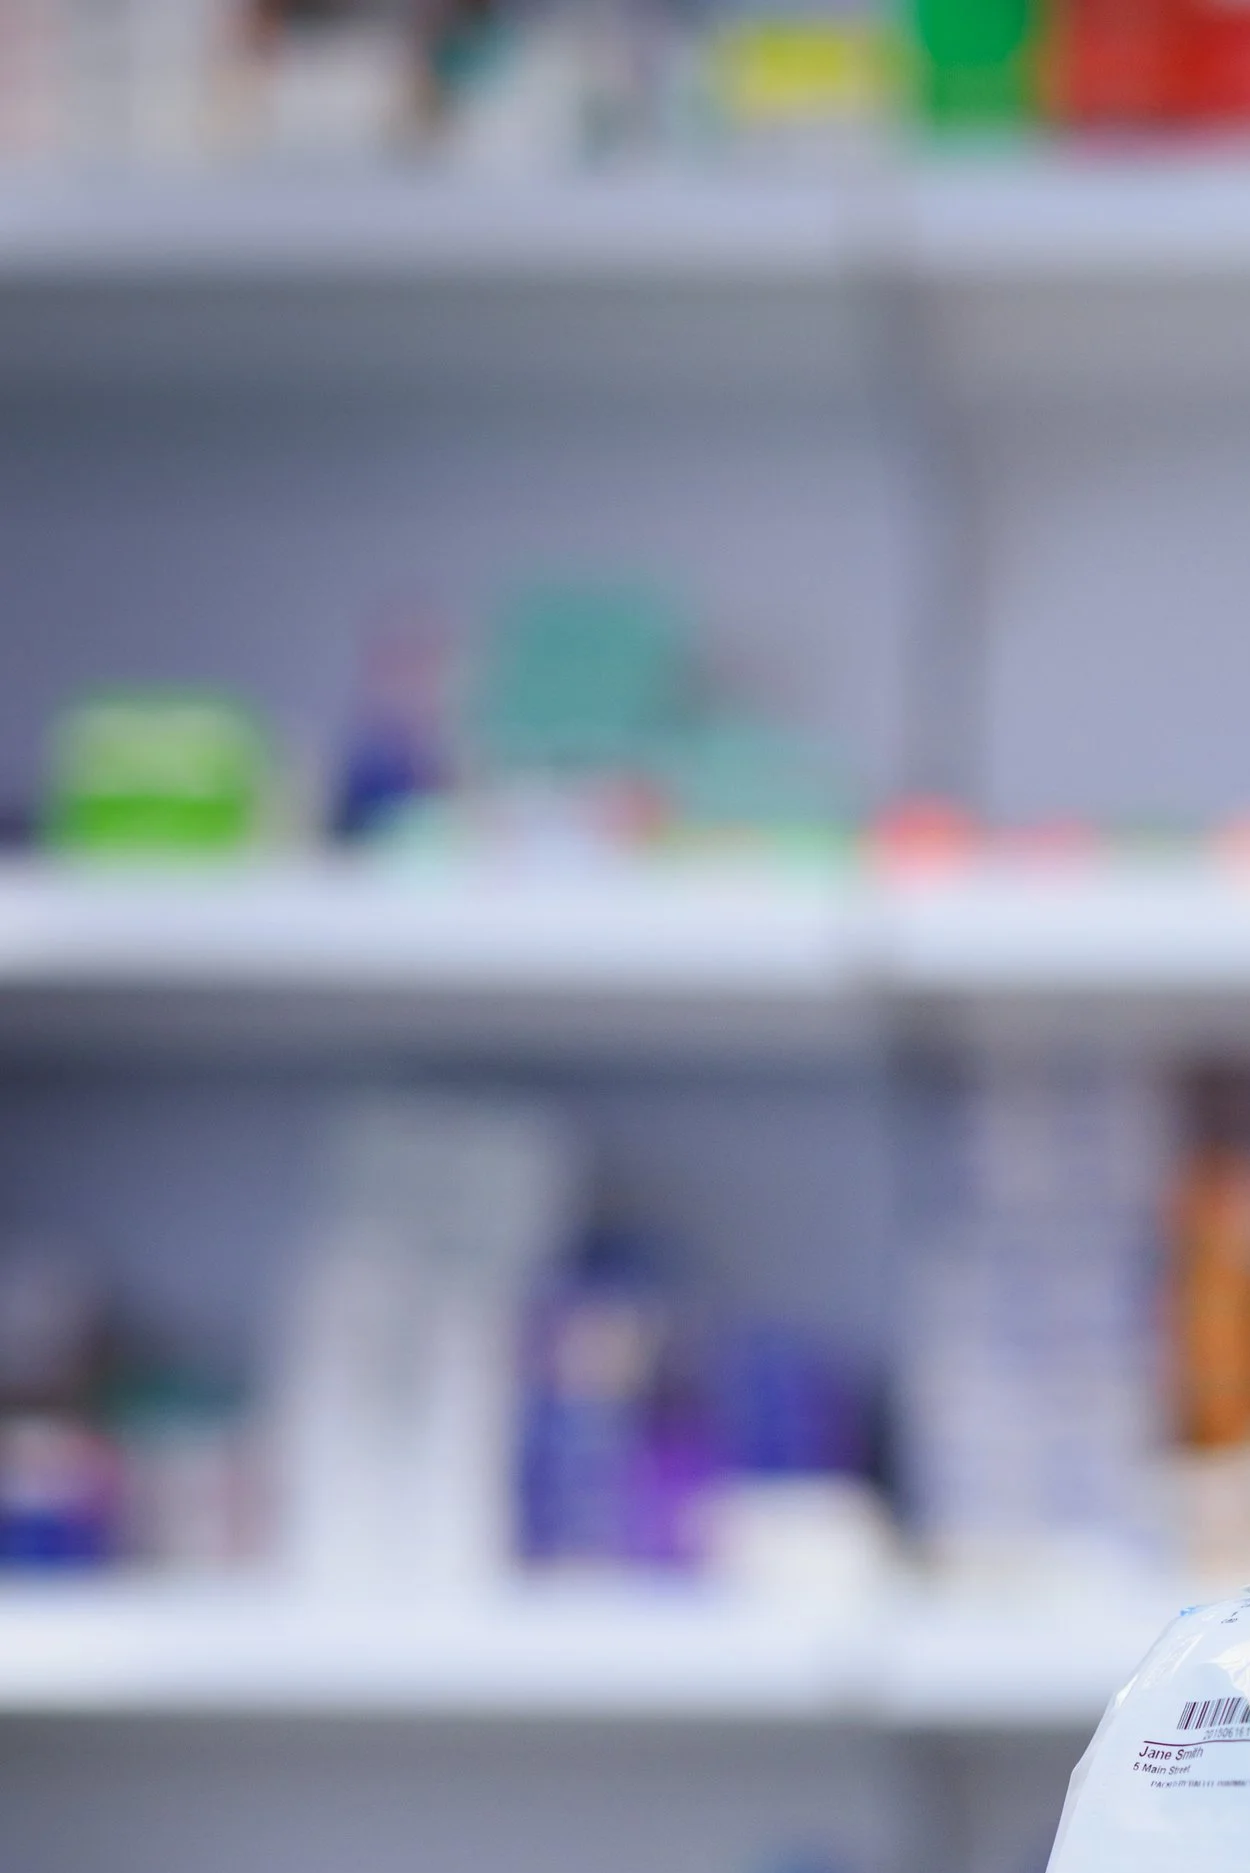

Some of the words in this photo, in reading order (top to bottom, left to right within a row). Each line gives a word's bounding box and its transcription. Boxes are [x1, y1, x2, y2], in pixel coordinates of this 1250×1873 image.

[1138, 1746, 1172, 1760] Jane
[1174, 1747, 1204, 1760] Smith
[1141, 1763, 1167, 1774] Main
[1168, 1764, 1191, 1774] Street
